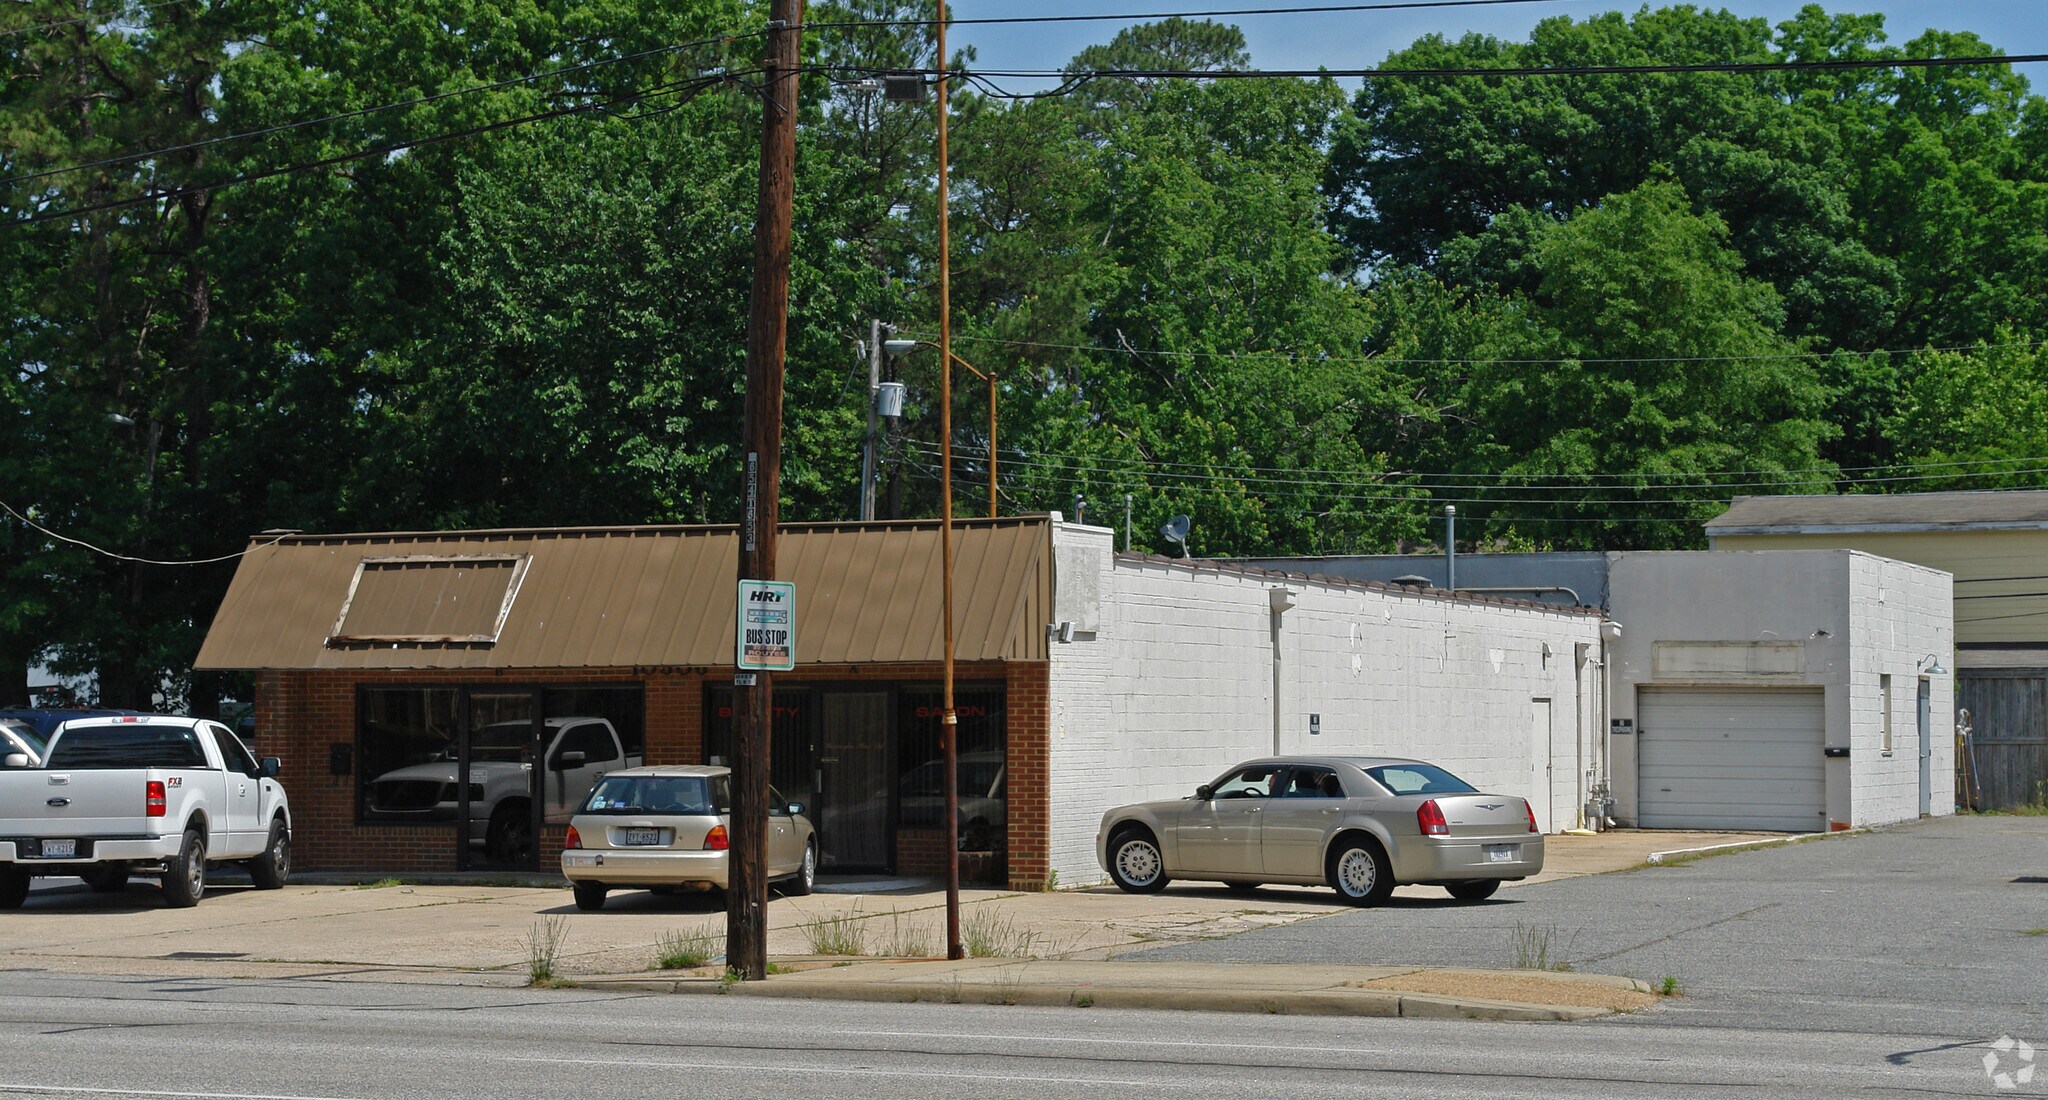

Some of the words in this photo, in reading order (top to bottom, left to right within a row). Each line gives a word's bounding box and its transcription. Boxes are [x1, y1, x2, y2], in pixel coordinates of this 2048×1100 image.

[750, 591, 786, 602] HRT
[746, 629, 763, 644] BUS
[765, 630, 787, 645] STOP
[719, 707, 798, 717] BTY
[916, 706, 985, 717] SAON
[168, 777, 182, 785] FX2
